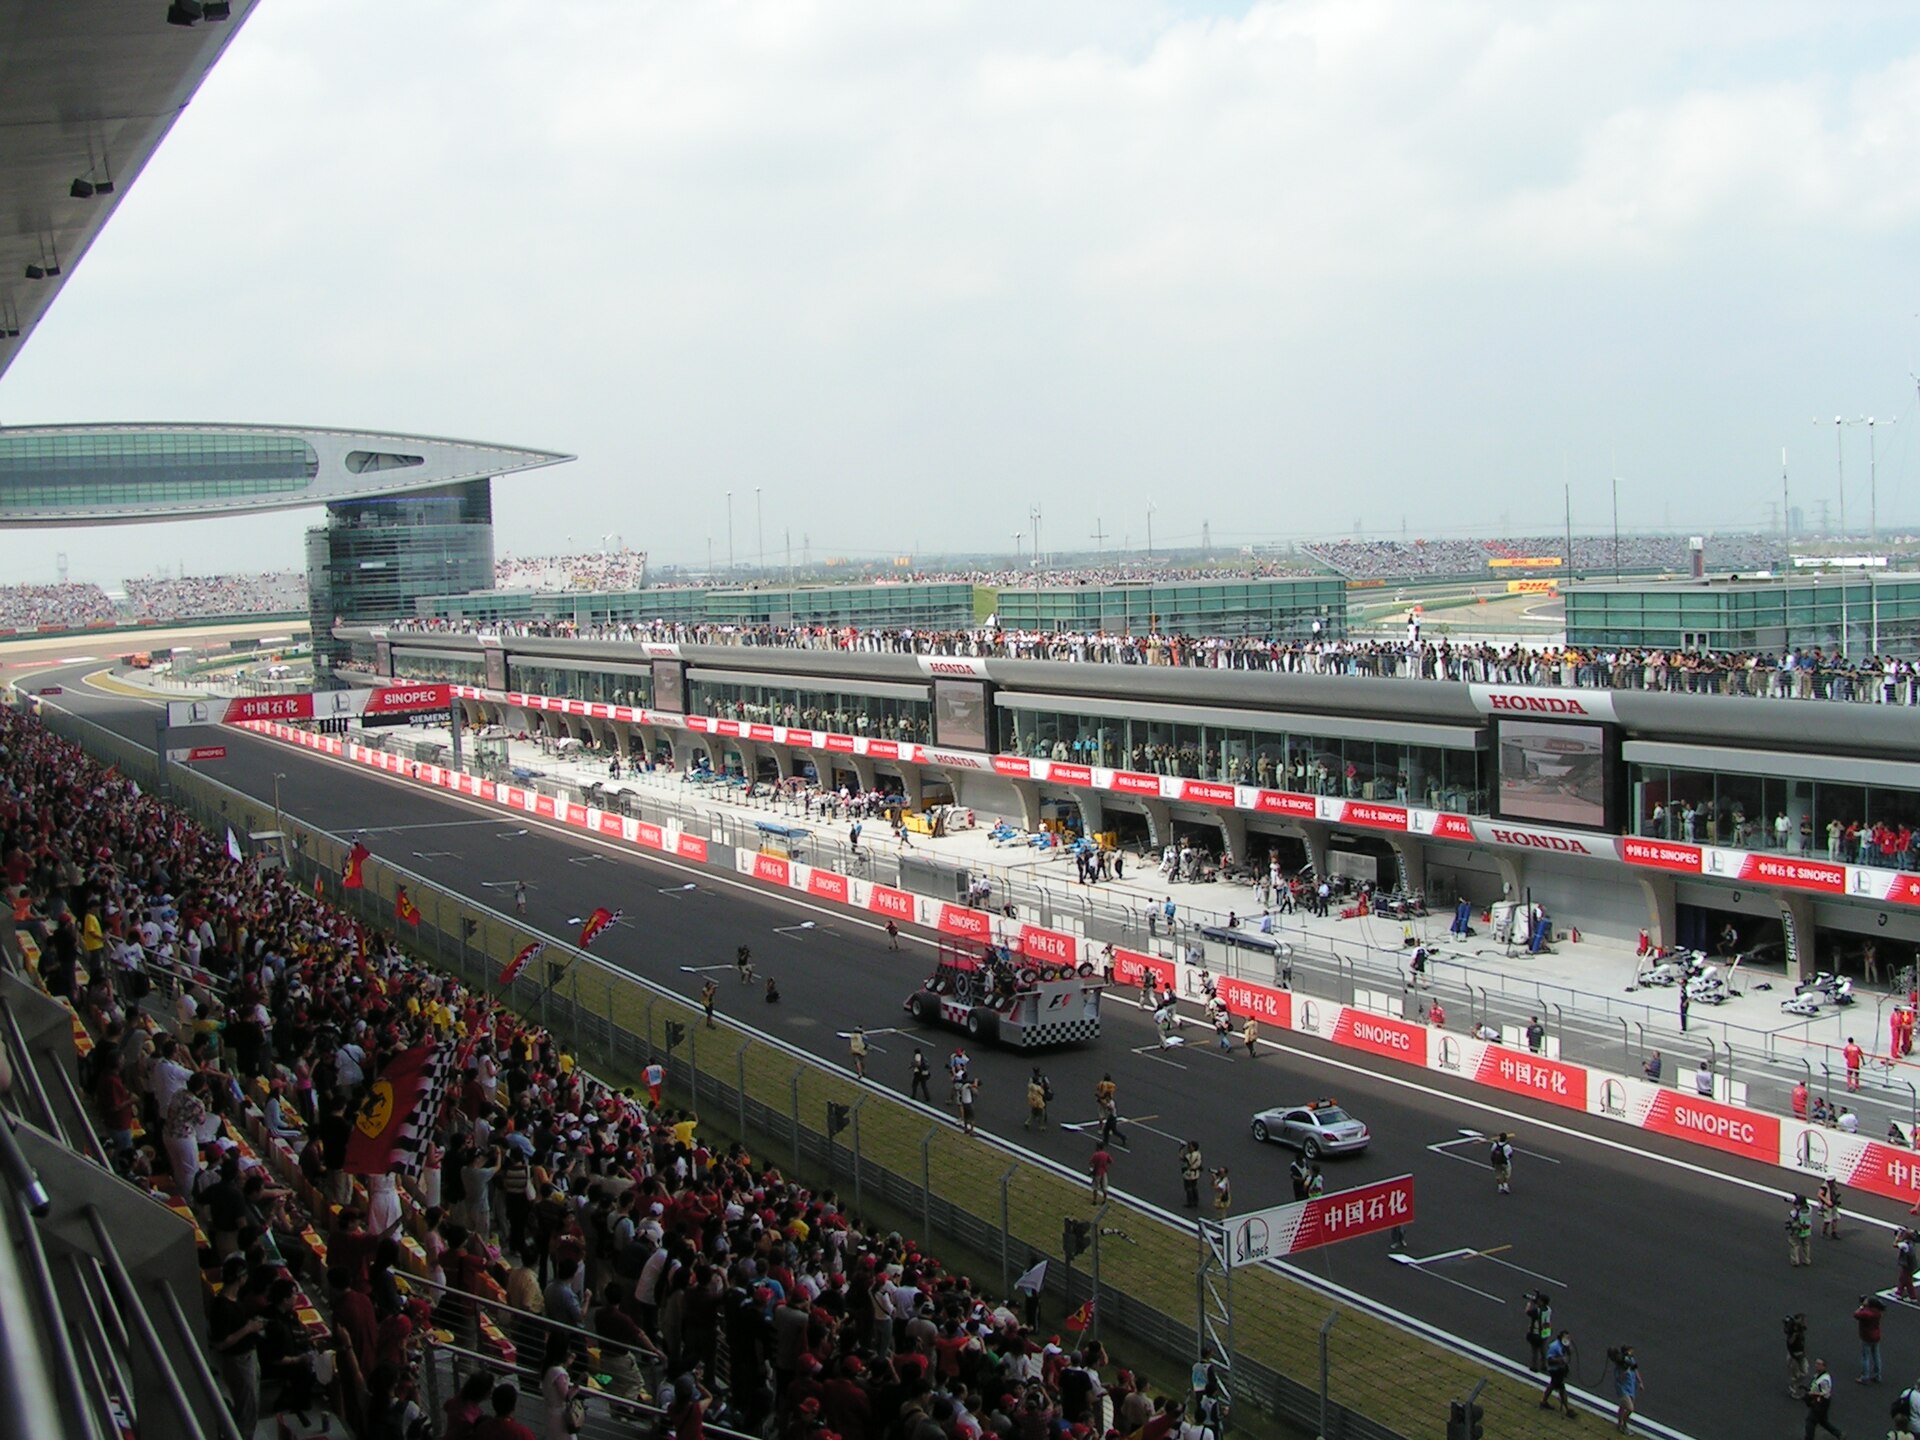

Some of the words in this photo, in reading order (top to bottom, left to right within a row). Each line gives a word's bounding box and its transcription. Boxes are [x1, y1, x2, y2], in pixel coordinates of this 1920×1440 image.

[1518, 582, 1550, 591] DHL
[930, 662, 976, 675] HONDA
[243, 699, 299, 717] 中国石化
[384, 690, 437, 705] SINOPEC
[1488, 694, 1590, 715] HONDA
[409, 712, 452, 724] SIEMENS
[934, 754, 981, 769] HONDA
[1377, 811, 1406, 824] SINOPEC
[1491, 829, 1592, 855] HONDA
[1626, 844, 1658, 859] 中国石化
[1659, 850, 1698, 865] SINOPEC
[1759, 862, 1795, 879] 中国石化
[1796, 868, 1841, 885] SINOPEC
[878, 892, 908, 913] 中国石化
[949, 913, 981, 933] SINOPEC
[1028, 932, 1066, 957] 中国石化
[1782, 911, 1798, 962] SIEMENS
[1121, 959, 1164, 984] SINOEC
[1048, 992, 1072, 1009] F1
[1228, 986, 1278, 1016] 中国石化
[1353, 1020, 1410, 1050] SINOPEC
[1500, 1057, 1567, 1094] 中国石化
[1674, 1106, 1755, 1144] SINOPEC
[1324, 1189, 1408, 1232] 中国石化
